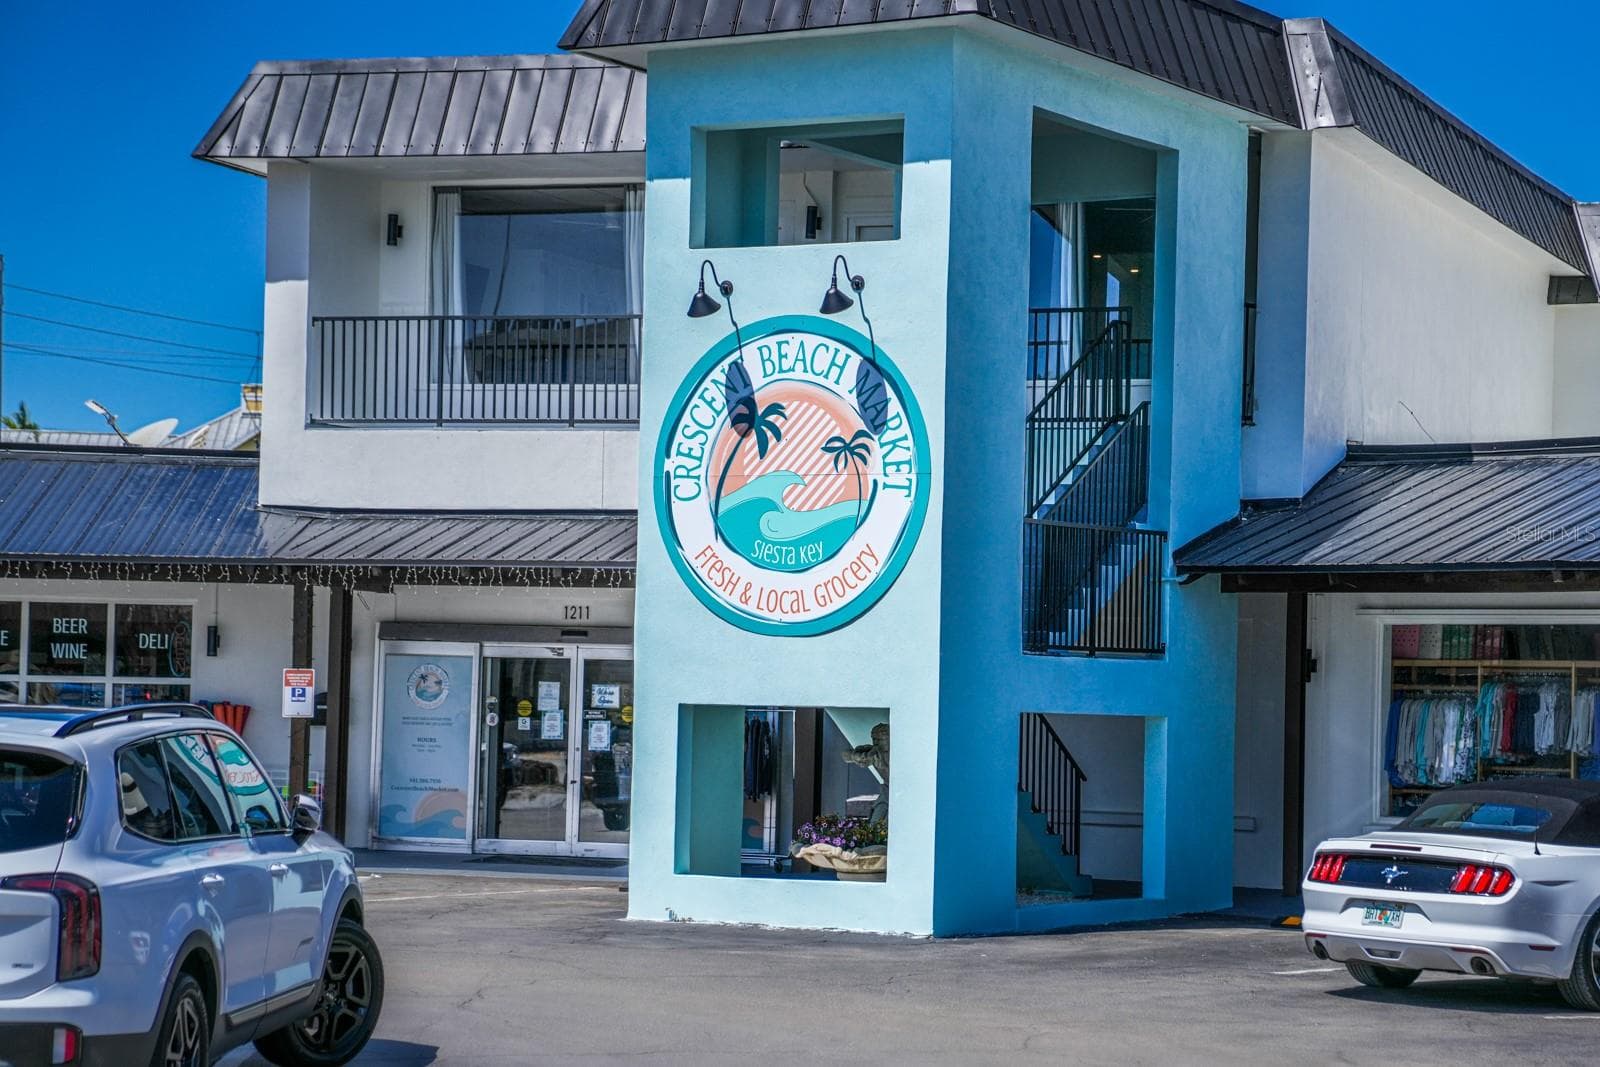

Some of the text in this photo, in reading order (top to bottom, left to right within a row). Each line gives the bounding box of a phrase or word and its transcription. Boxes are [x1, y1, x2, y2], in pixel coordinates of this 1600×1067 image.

[673, 340, 913, 502] CRESCENT BEACH MARKET
[739, 581, 753, 606] &
[564, 605, 590, 620] 1211
[53, 617, 88, 634] BEER
[139, 633, 169, 649] DELI
[50, 643, 88, 659] WINE
[295, 688, 304, 698] P
